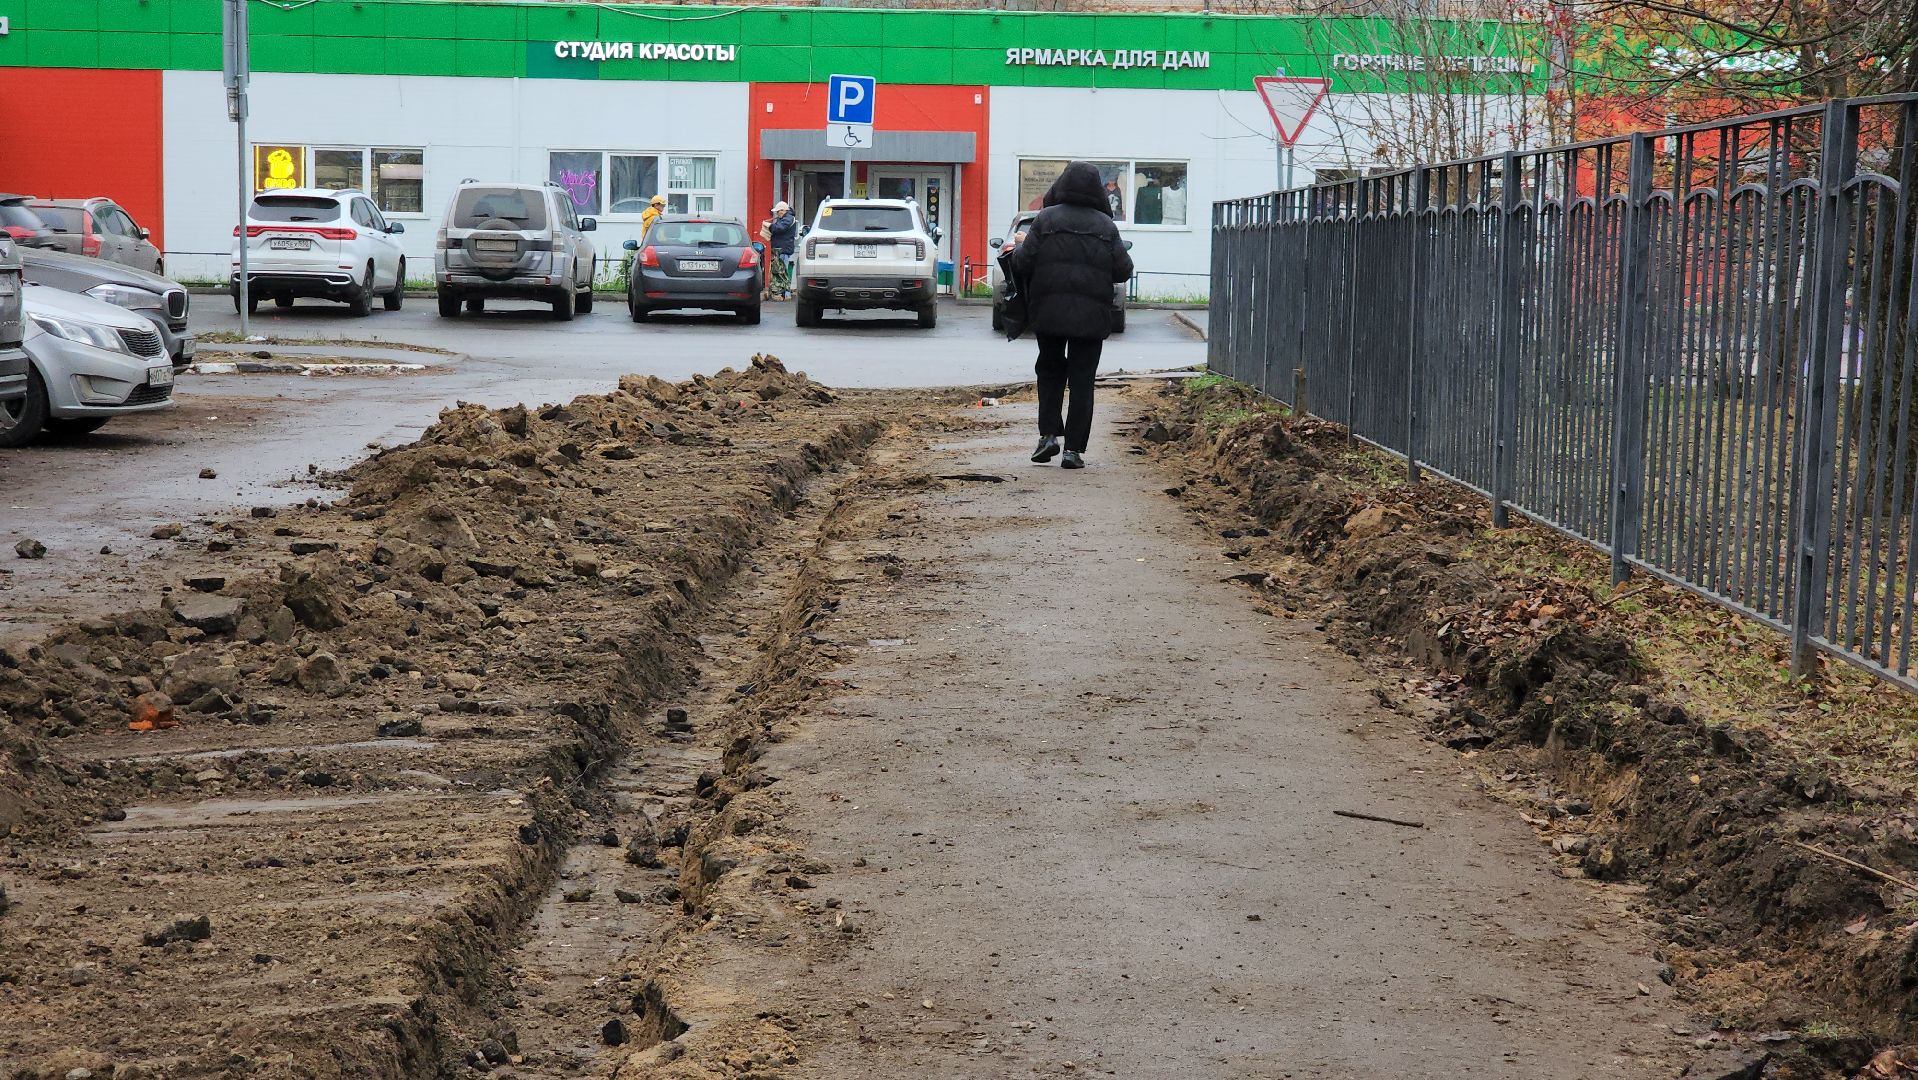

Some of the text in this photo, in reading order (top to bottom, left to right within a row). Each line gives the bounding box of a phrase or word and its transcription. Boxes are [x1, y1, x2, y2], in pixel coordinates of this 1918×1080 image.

[554, 41, 735, 61] СТУДИЯ КРАСОТЫ
[1005, 48, 1210, 71] ЯРМАРКА ДЛЯ ДАМ
[1333, 53, 1425, 71] ГОРЯЧИЕ
[838, 80, 865, 118] P
